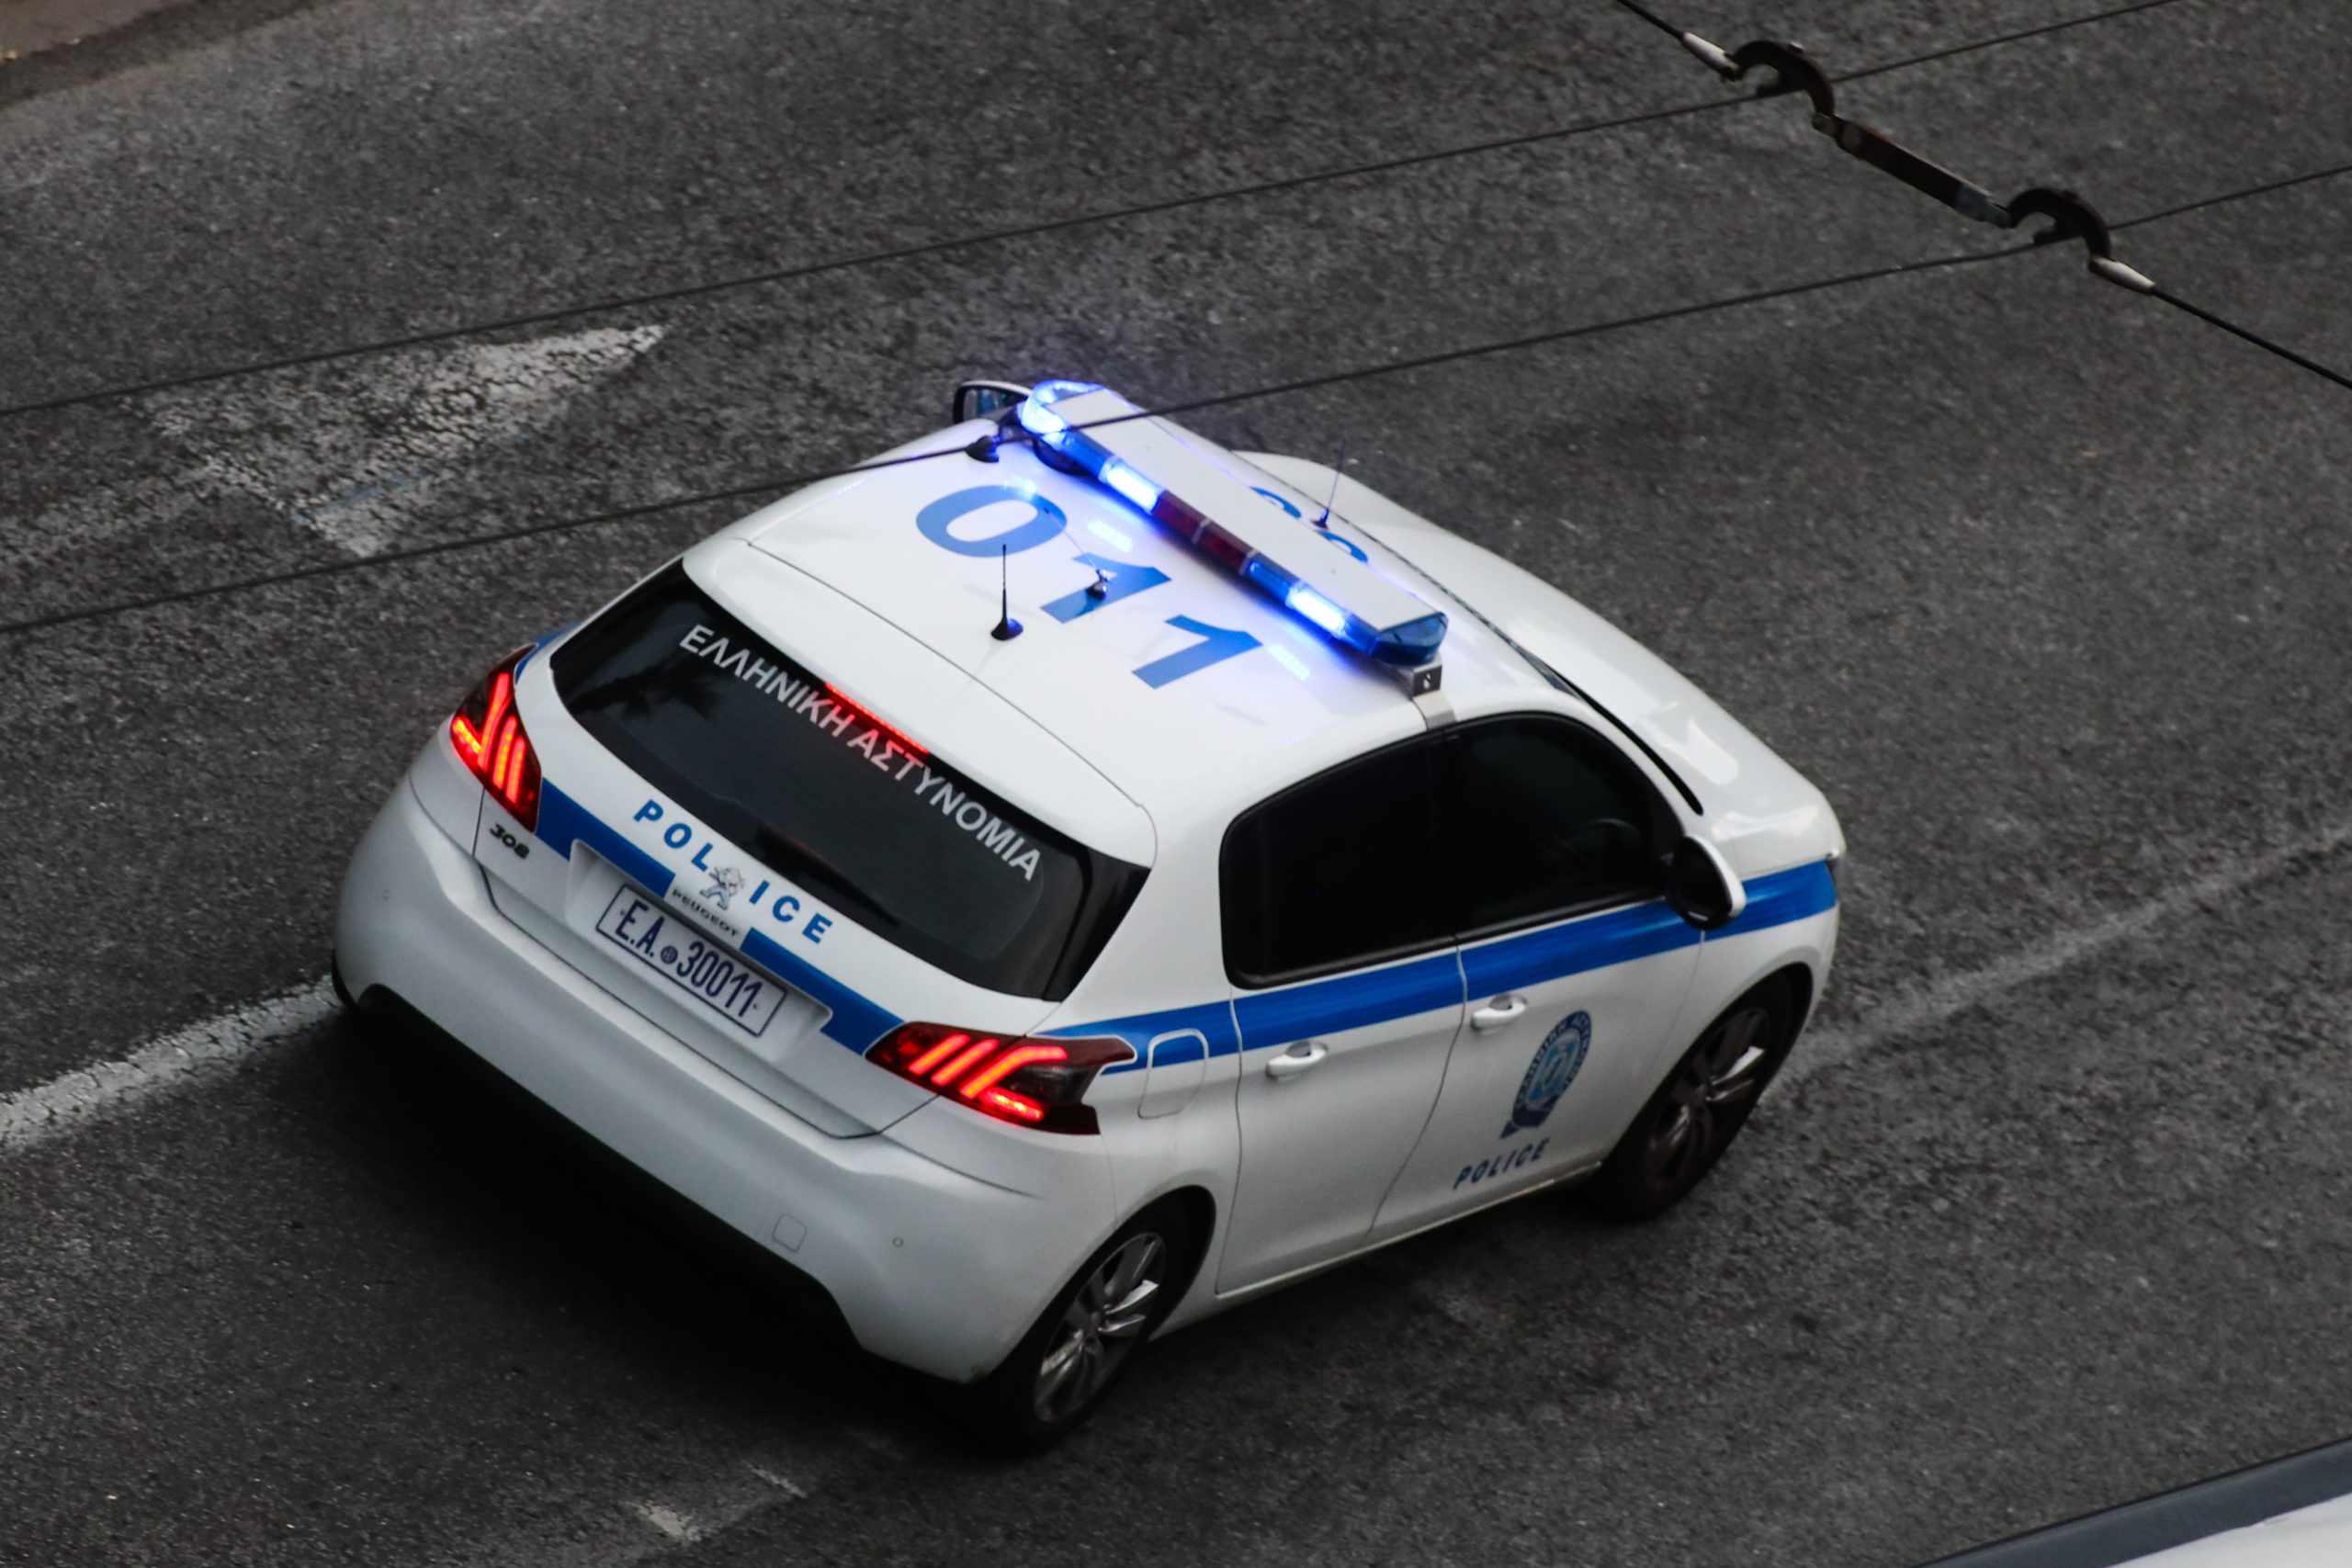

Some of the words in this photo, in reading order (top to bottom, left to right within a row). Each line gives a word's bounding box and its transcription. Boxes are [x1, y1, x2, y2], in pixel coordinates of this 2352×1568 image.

[916, 485, 1262, 689] 011
[680, 624, 855, 738] ΕΛΛΗΝΙΚΗ
[847, 728, 1041, 882] ΑΣΤΥΝΟΜΙΑ
[490, 823, 530, 860] 308
[633, 799, 832, 944] POLICE
[673, 887, 739, 936] PEUGEOT
[676, 935, 763, 1018] 30011
[1453, 1137, 1550, 1190] POLICE
